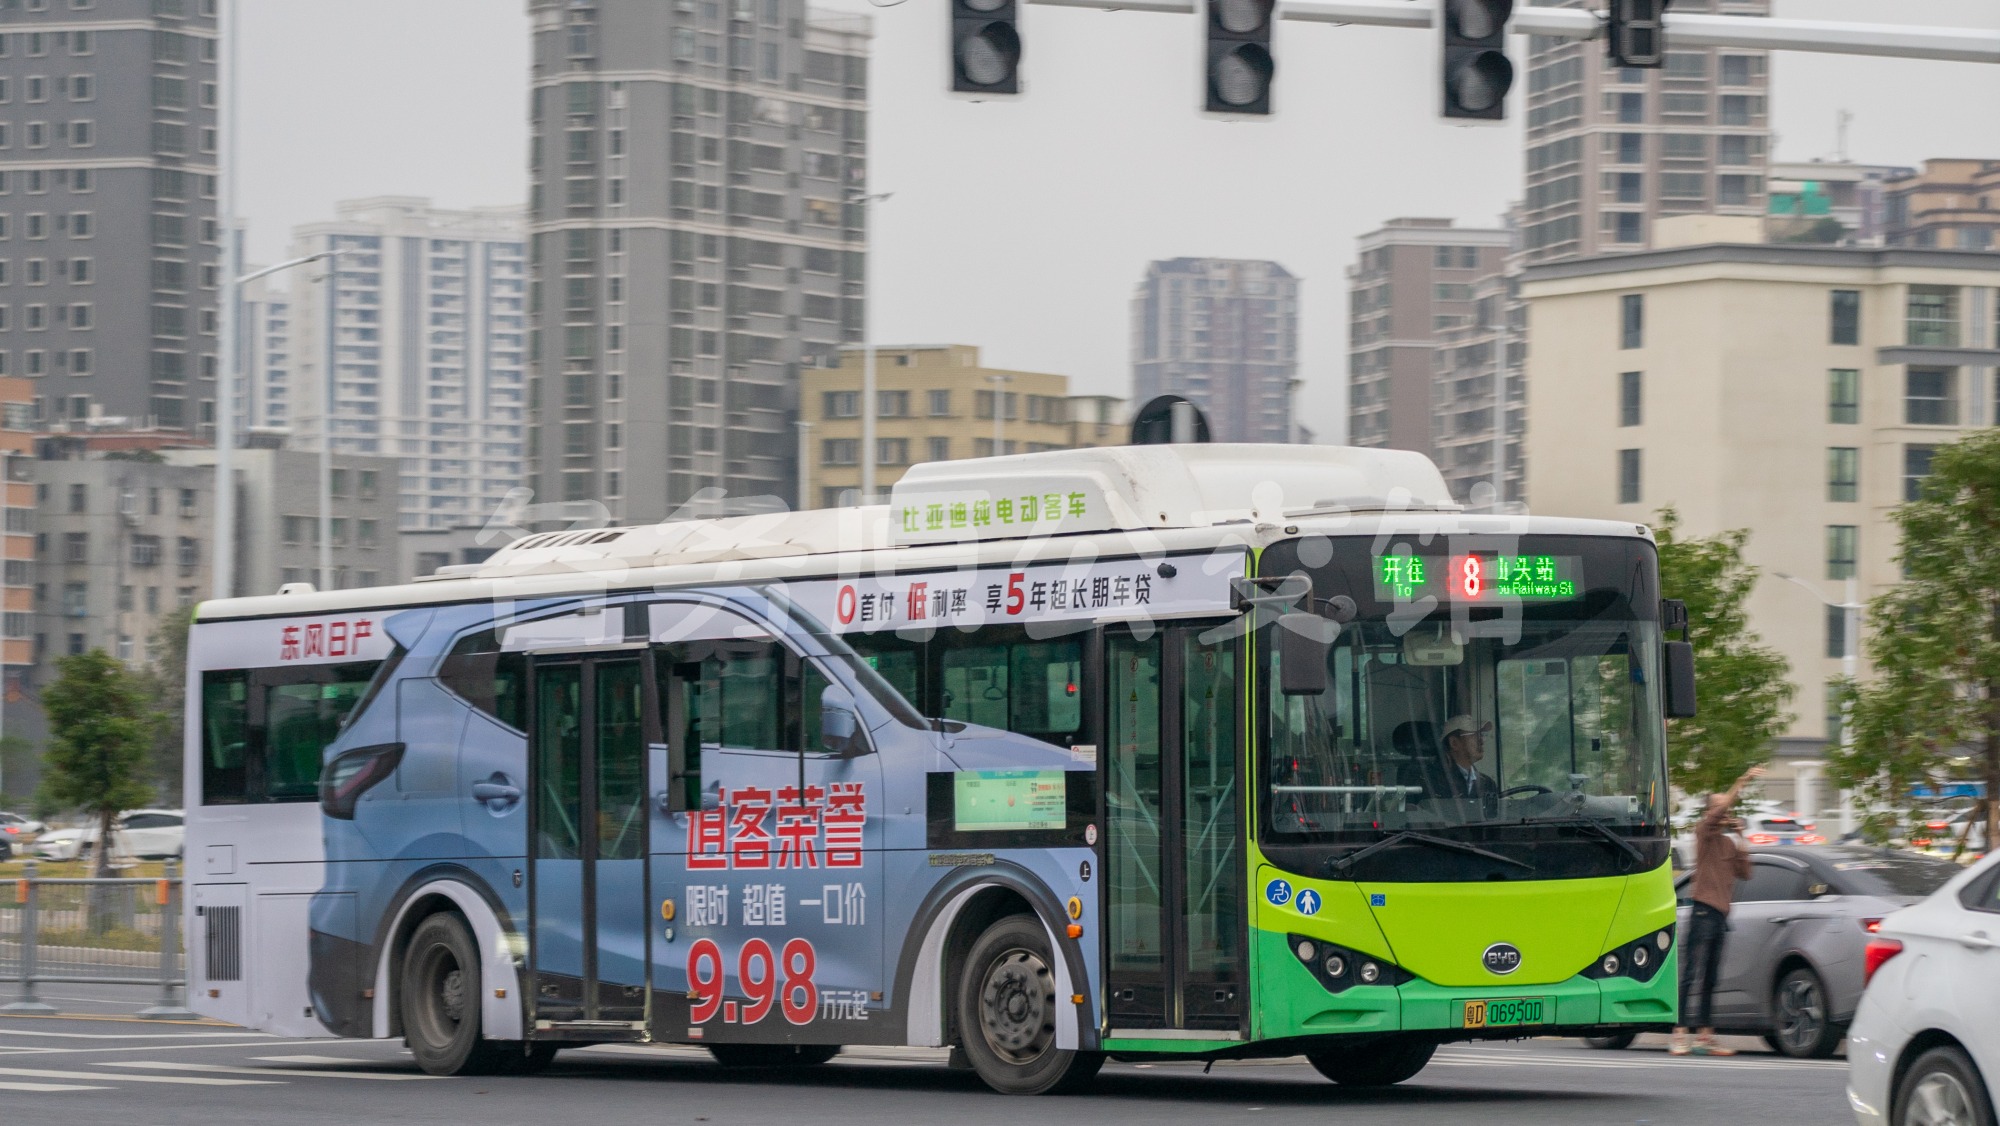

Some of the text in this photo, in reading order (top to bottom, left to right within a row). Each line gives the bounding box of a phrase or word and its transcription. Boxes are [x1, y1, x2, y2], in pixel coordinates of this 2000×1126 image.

[903, 491, 1086, 532] 比亚迪纯电动客车
[1396, 583, 1412, 596] To
[1463, 557, 1480, 596] 8
[1512, 581, 1557, 598] Railway
[837, 573, 1151, 625] 0首付 低利率 享5年超长期车贷
[281, 618, 372, 661] 东风日产
[686, 782, 866, 870] 逍客荣誉
[686, 883, 866, 926] 限时 超值 一口价
[1487, 951, 1518, 964] BYD
[687, 937, 869, 1026] 9.98 万元起
